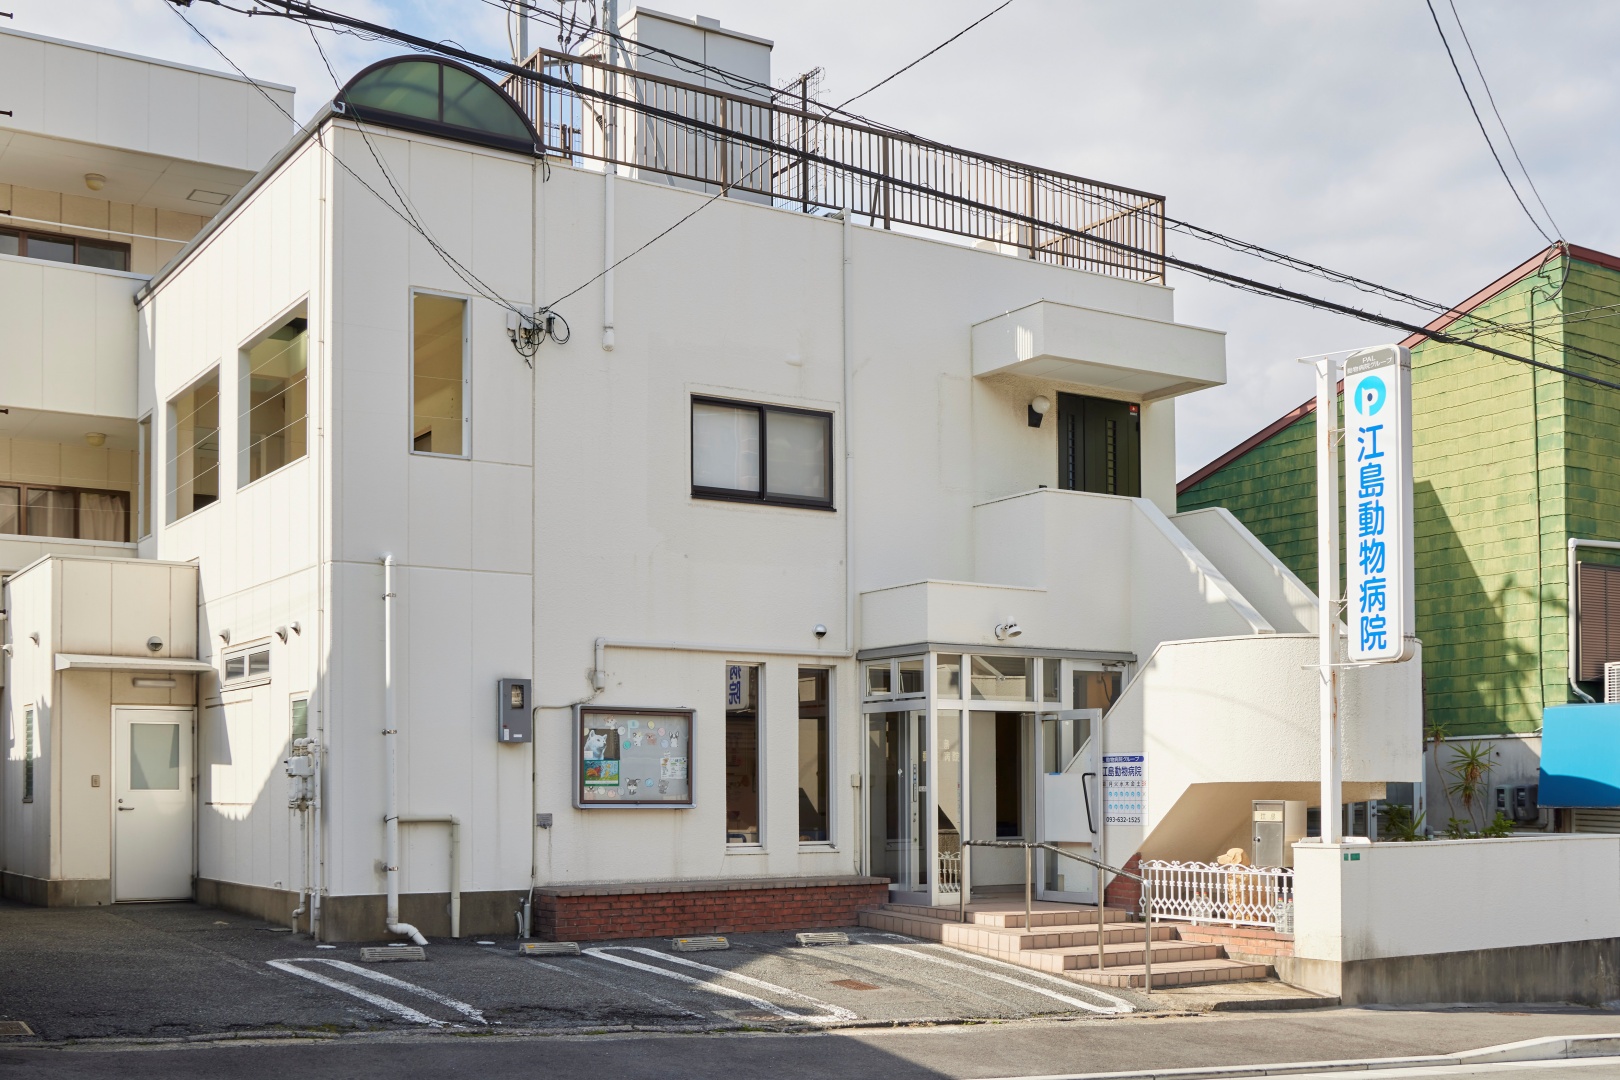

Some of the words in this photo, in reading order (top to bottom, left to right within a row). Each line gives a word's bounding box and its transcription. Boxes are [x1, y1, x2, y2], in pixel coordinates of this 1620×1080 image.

[1347, 357, 1393, 373] 動物病院グループ
[1357, 424, 1387, 652] 江島動物病院
